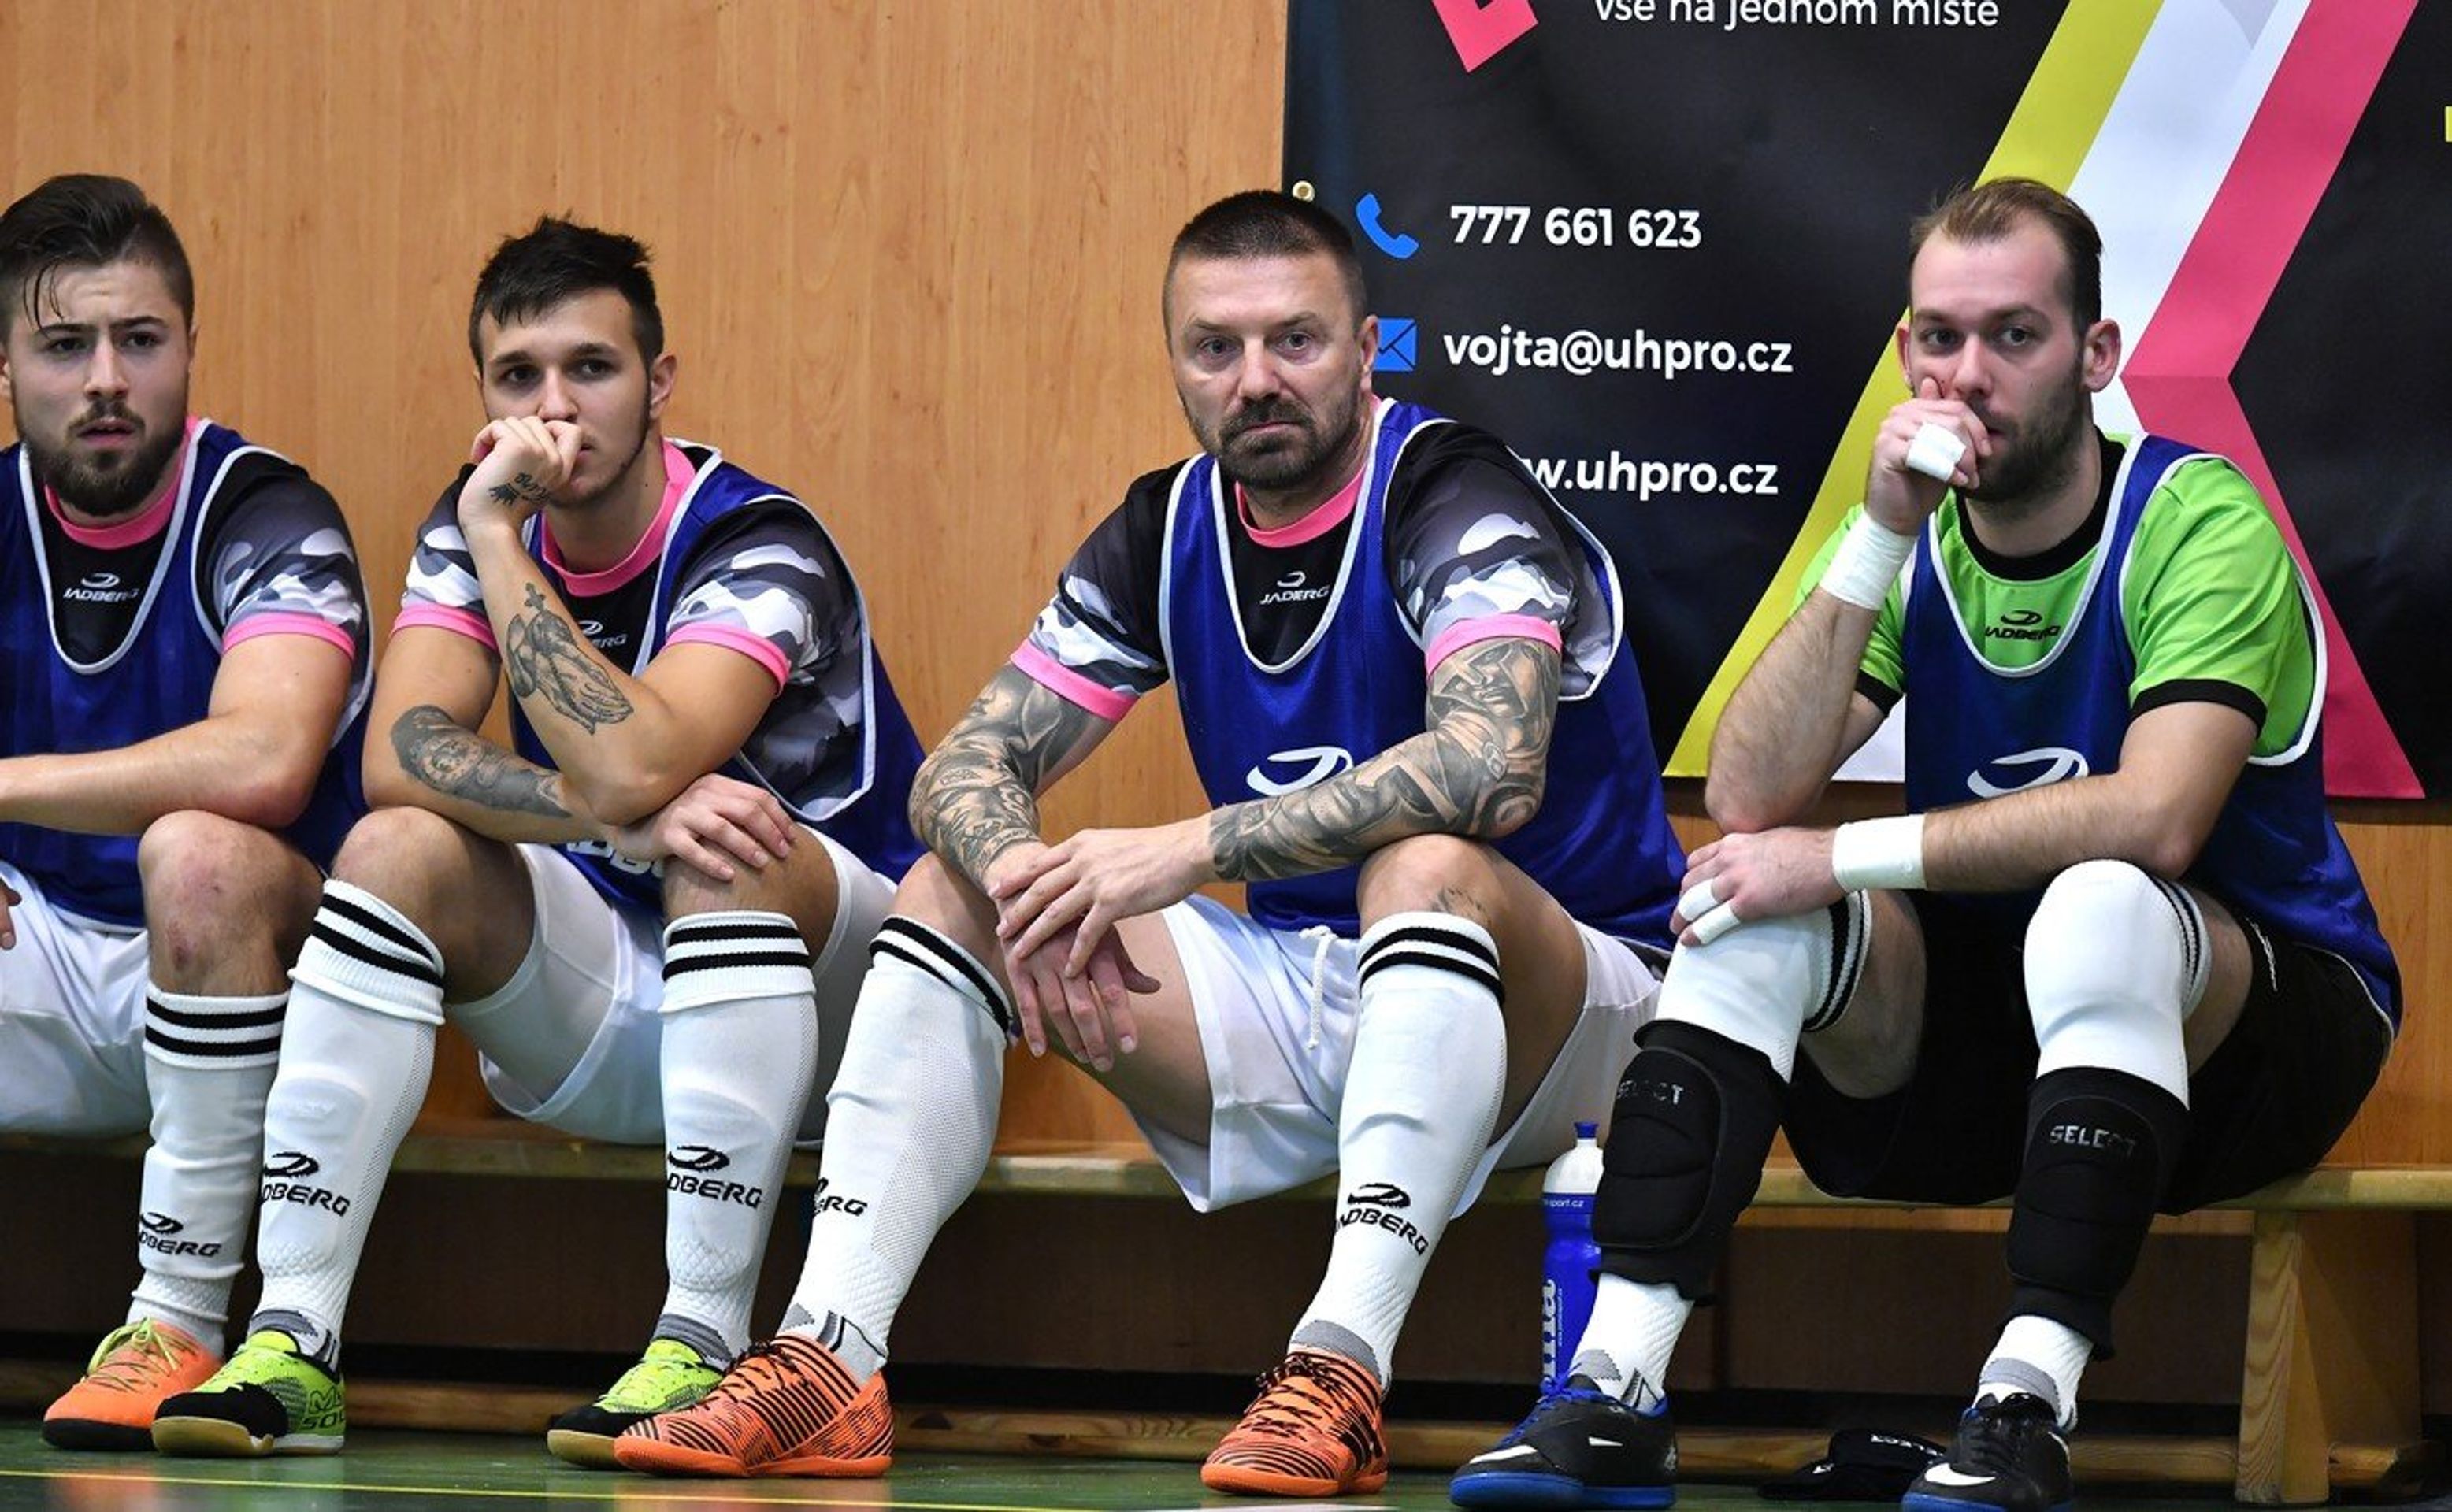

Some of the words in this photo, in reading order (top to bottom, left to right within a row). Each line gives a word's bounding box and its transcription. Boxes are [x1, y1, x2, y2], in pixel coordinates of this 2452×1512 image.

[1669, 0, 1716, 23] na
[1450, 205, 1531, 244] 777
[1544, 206, 1613, 246] 661
[1627, 209, 1702, 248] 623
[1443, 324, 1794, 380] vojta@uhpro.cz
[1520, 450, 1779, 501] w.uhpro.cz
[666, 1173, 762, 1209] DBERG
